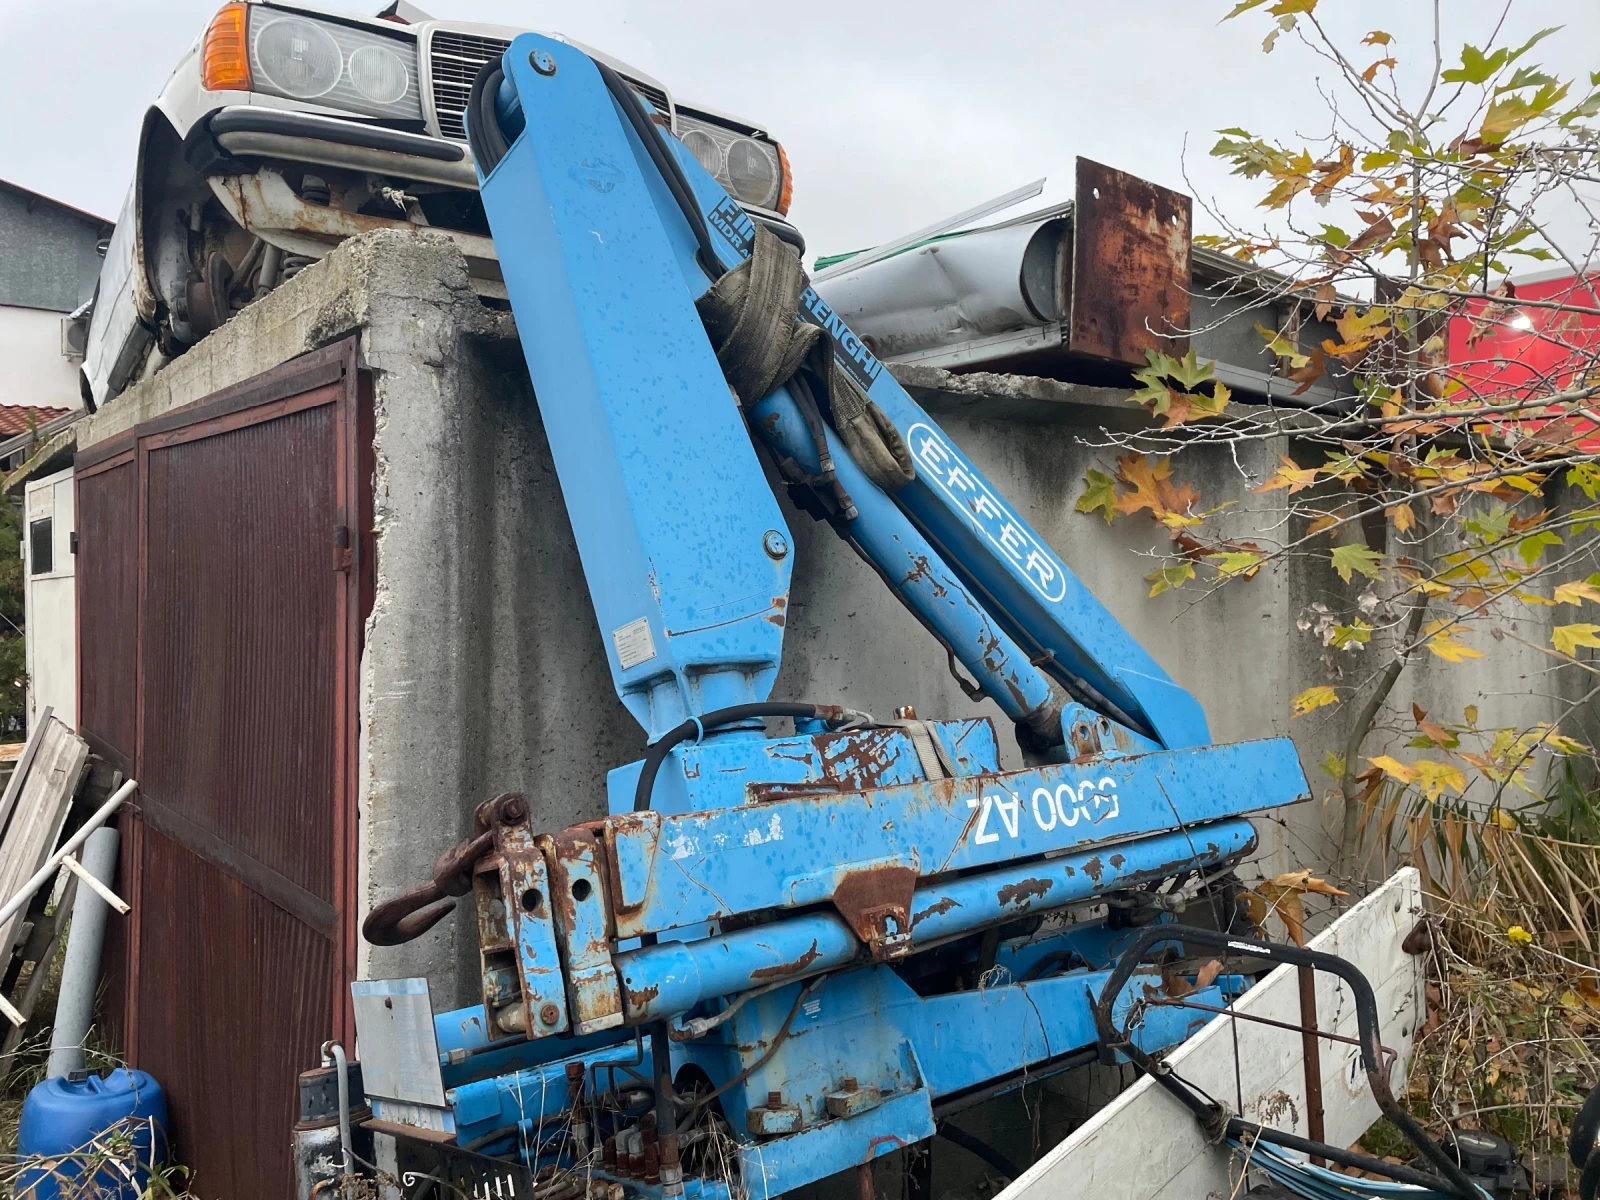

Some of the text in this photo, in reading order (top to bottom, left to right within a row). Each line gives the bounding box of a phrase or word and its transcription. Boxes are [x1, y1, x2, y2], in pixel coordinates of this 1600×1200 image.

[709, 211, 743, 249] MDR
[800, 286, 882, 380] RENGHI
[919, 436, 1055, 591] EFFER
[966, 791, 1019, 845] AZ
